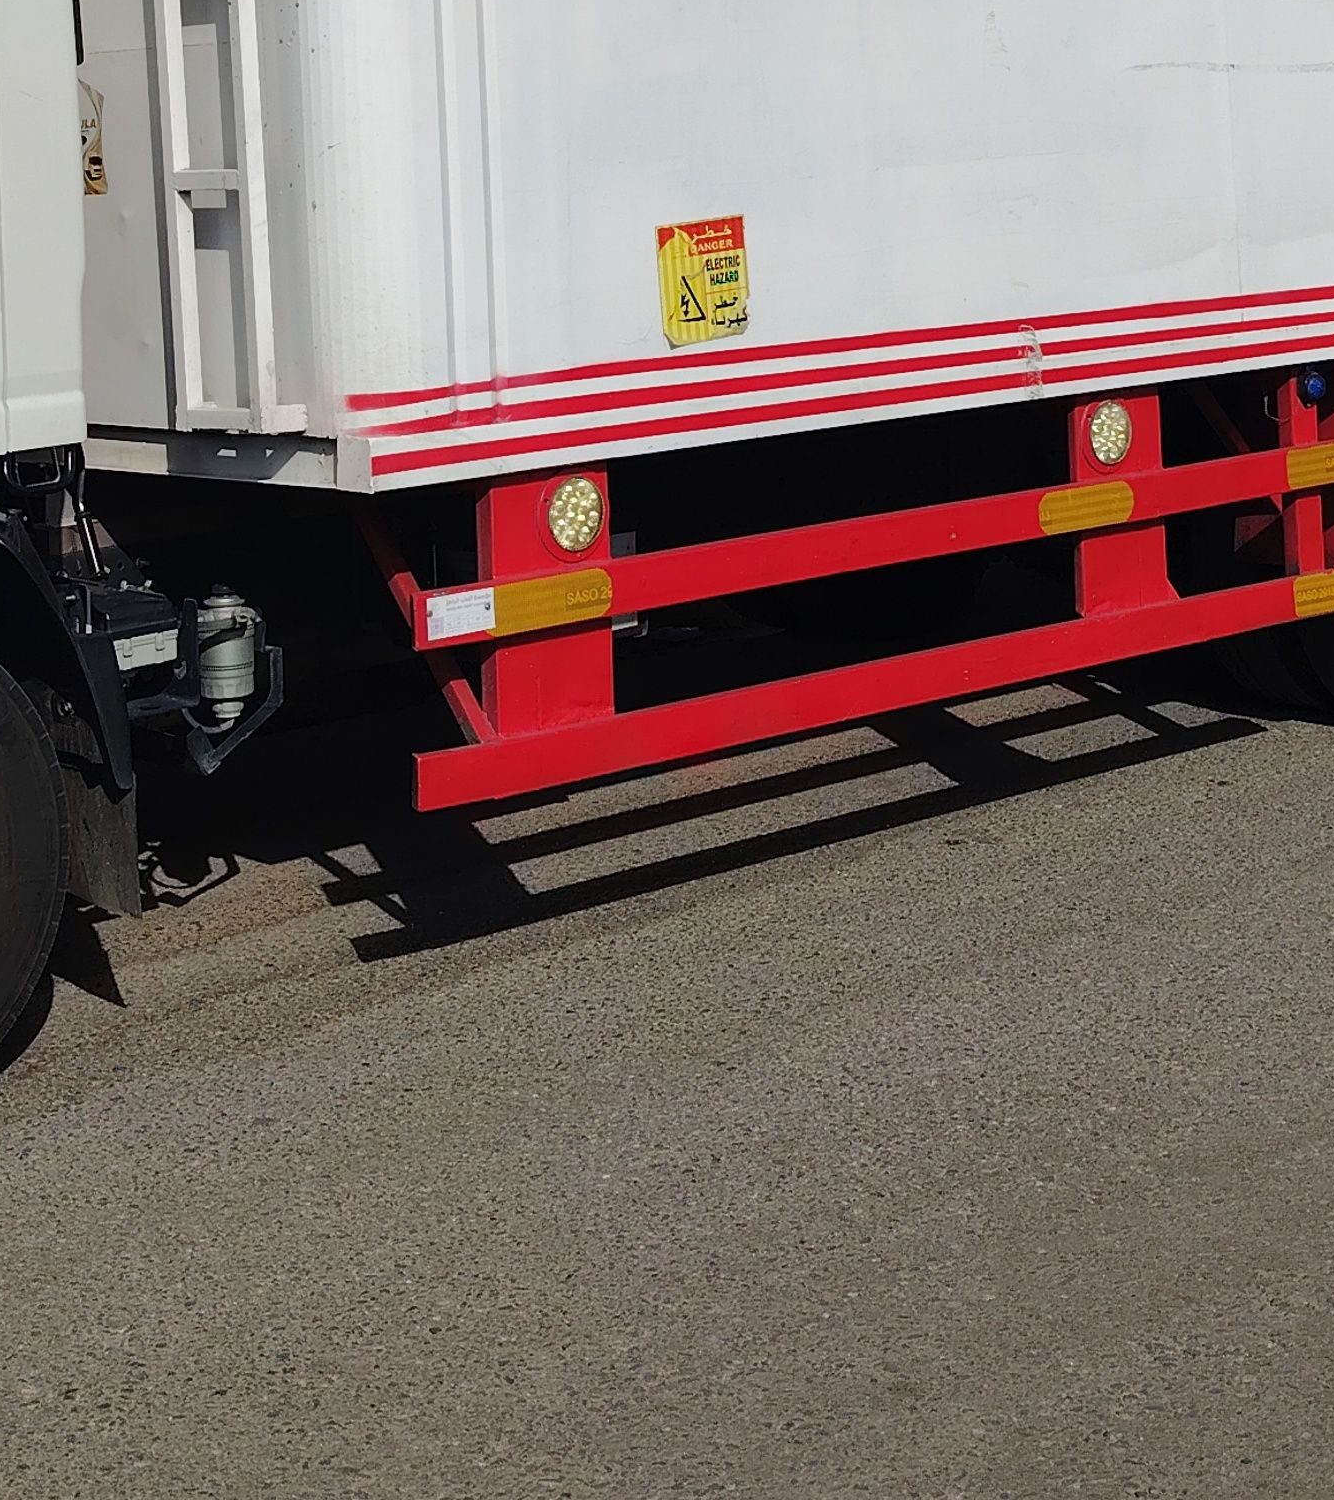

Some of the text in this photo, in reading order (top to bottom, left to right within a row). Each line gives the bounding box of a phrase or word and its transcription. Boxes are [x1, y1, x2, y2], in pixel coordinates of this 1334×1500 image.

[692, 224, 732, 244] خطر
[690, 238, 734, 254] DANGER
[705, 255, 741, 272] ELECTRIC
[709, 270, 739, 286] HAZARD
[714, 291, 739, 309] خطر
[566, 588, 598, 606] SASO
